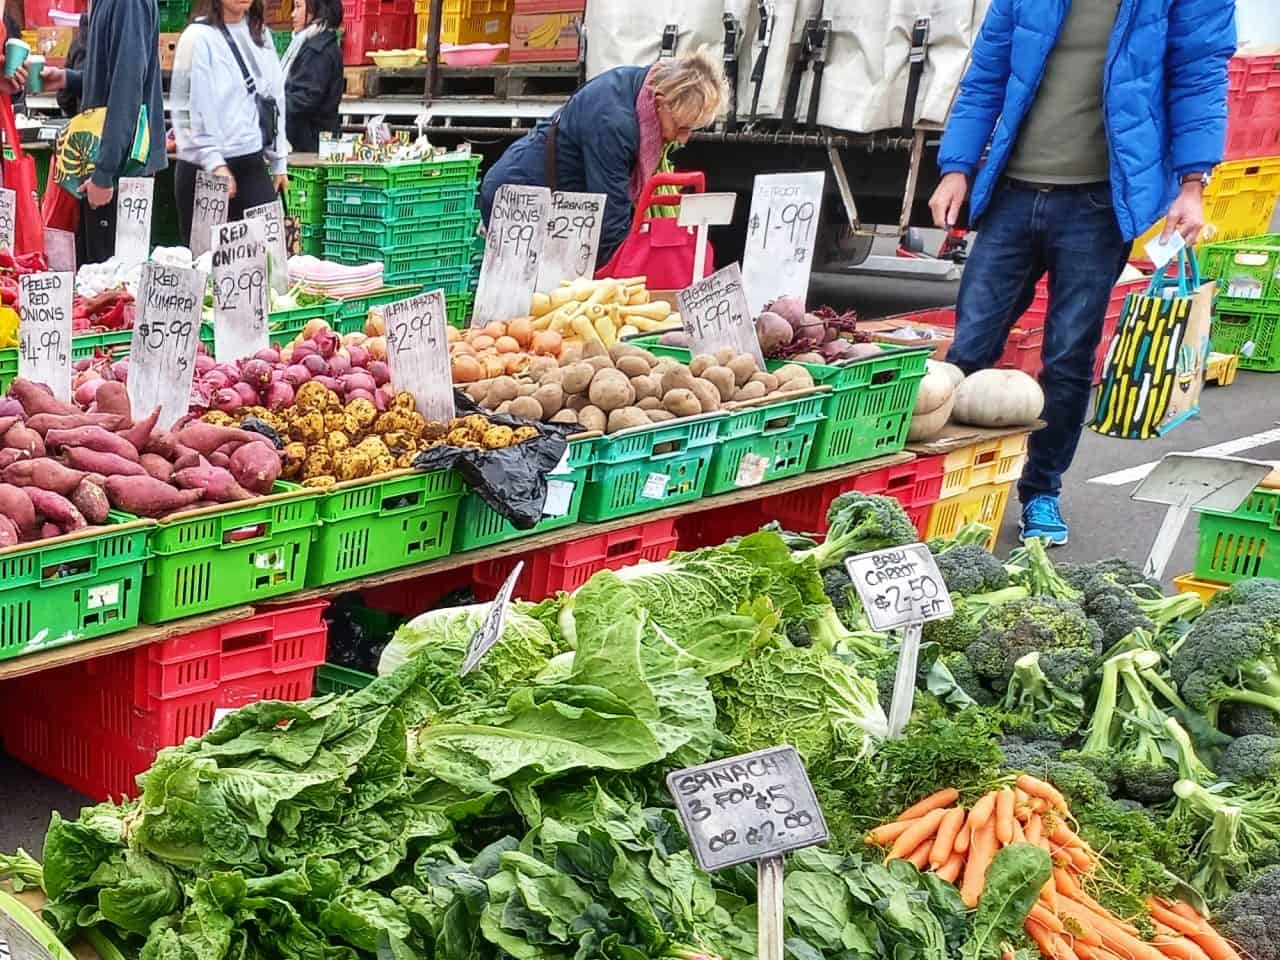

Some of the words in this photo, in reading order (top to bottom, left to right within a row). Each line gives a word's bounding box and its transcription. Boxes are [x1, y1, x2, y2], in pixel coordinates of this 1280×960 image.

[500, 187, 539, 206] WHITE
[493, 205, 540, 223] ONIONS
[220, 223, 249, 246] RED
[22, 275, 61, 291] PEELED
[152, 266, 179, 287] RED
[28, 292, 50, 306] RED
[148, 286, 194, 313] KUMARA
[20, 306, 65, 322] ONIONS
[864, 562, 919, 586] CARROT
[678, 757, 781, 797] SPINACH
[687, 798, 712, 822] 3
[712, 782, 756, 810] FOR
[755, 784, 796, 814] $5
[708, 828, 740, 852] OR
